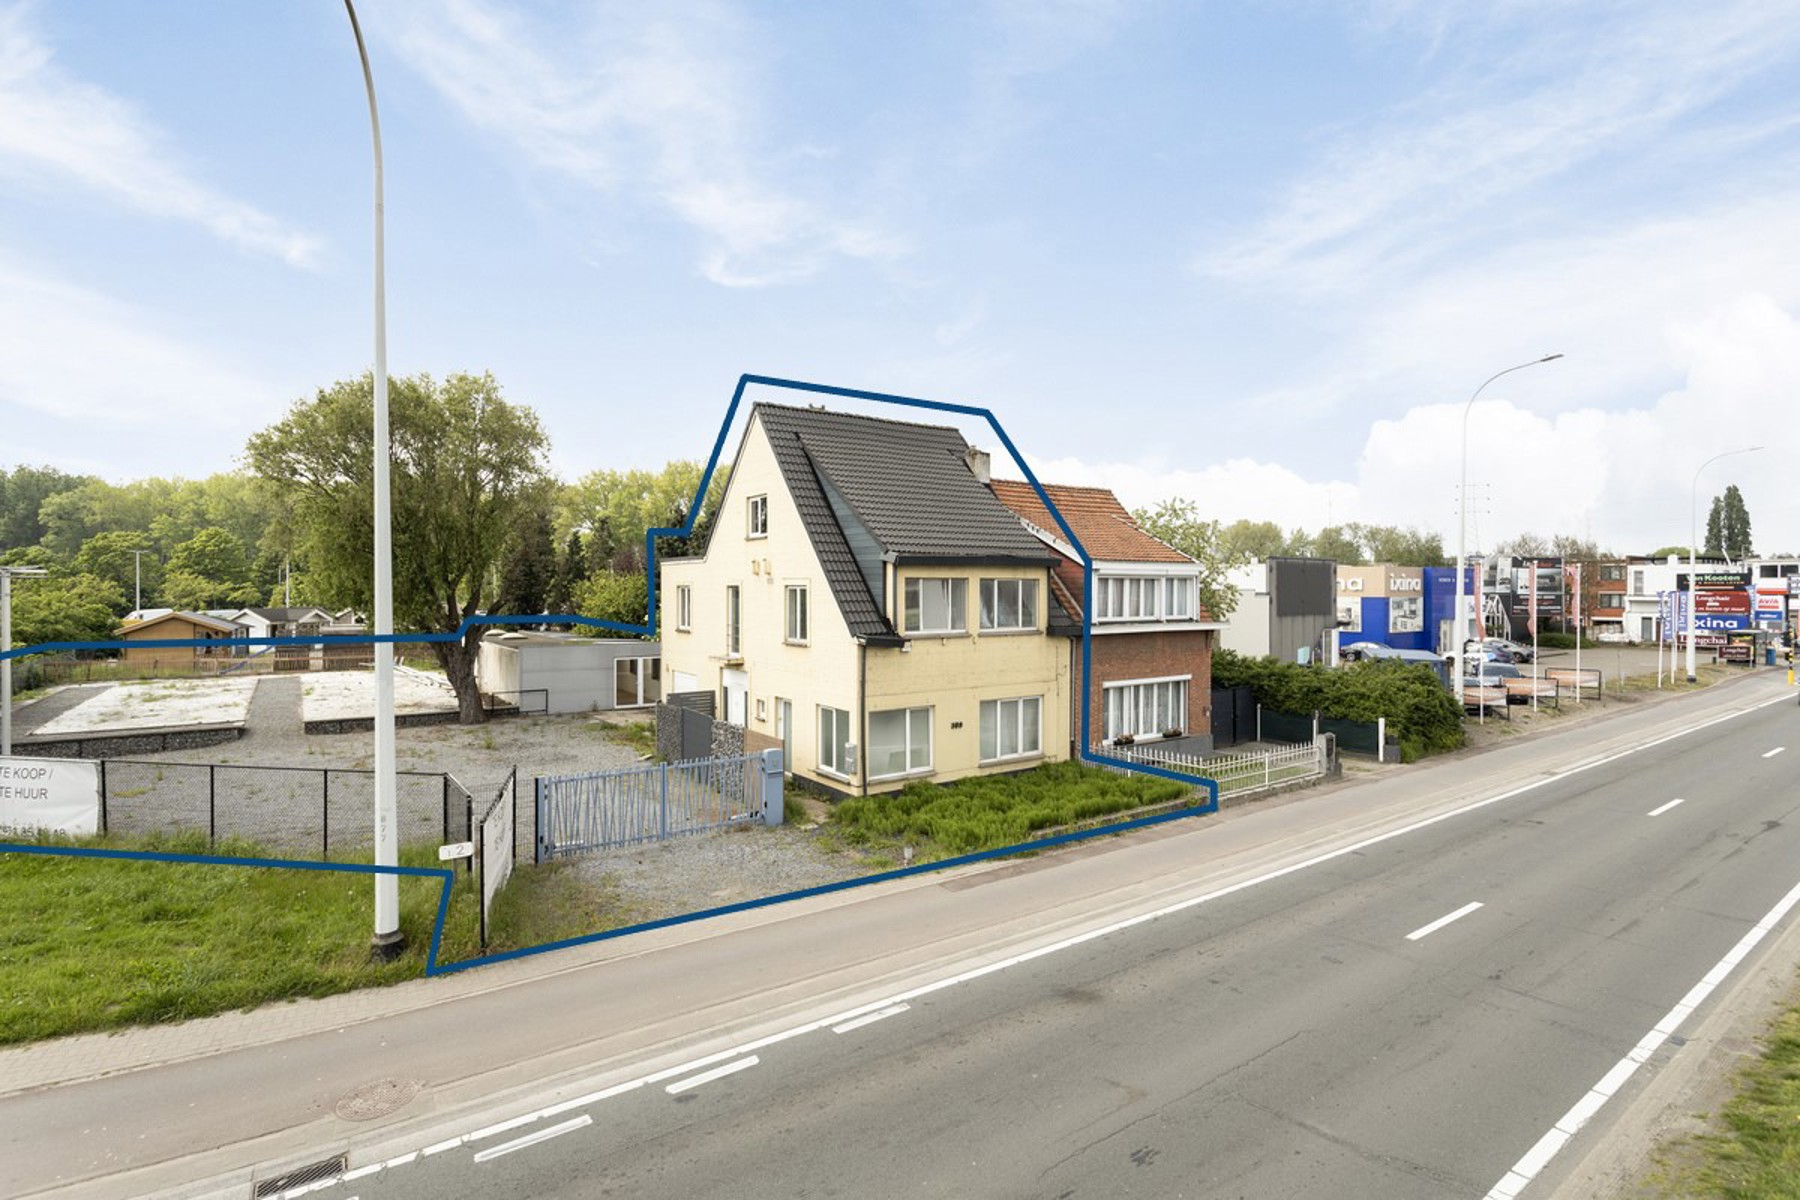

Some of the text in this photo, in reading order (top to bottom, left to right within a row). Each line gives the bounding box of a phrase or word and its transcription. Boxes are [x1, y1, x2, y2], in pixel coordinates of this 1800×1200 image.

[1390, 572, 1422, 591] ixina
[1694, 617, 1738, 628] xina
[1680, 635, 1728, 645] Lngchai
[13, 767, 47, 780] KOOP
[14, 787, 49, 800] HUUR
